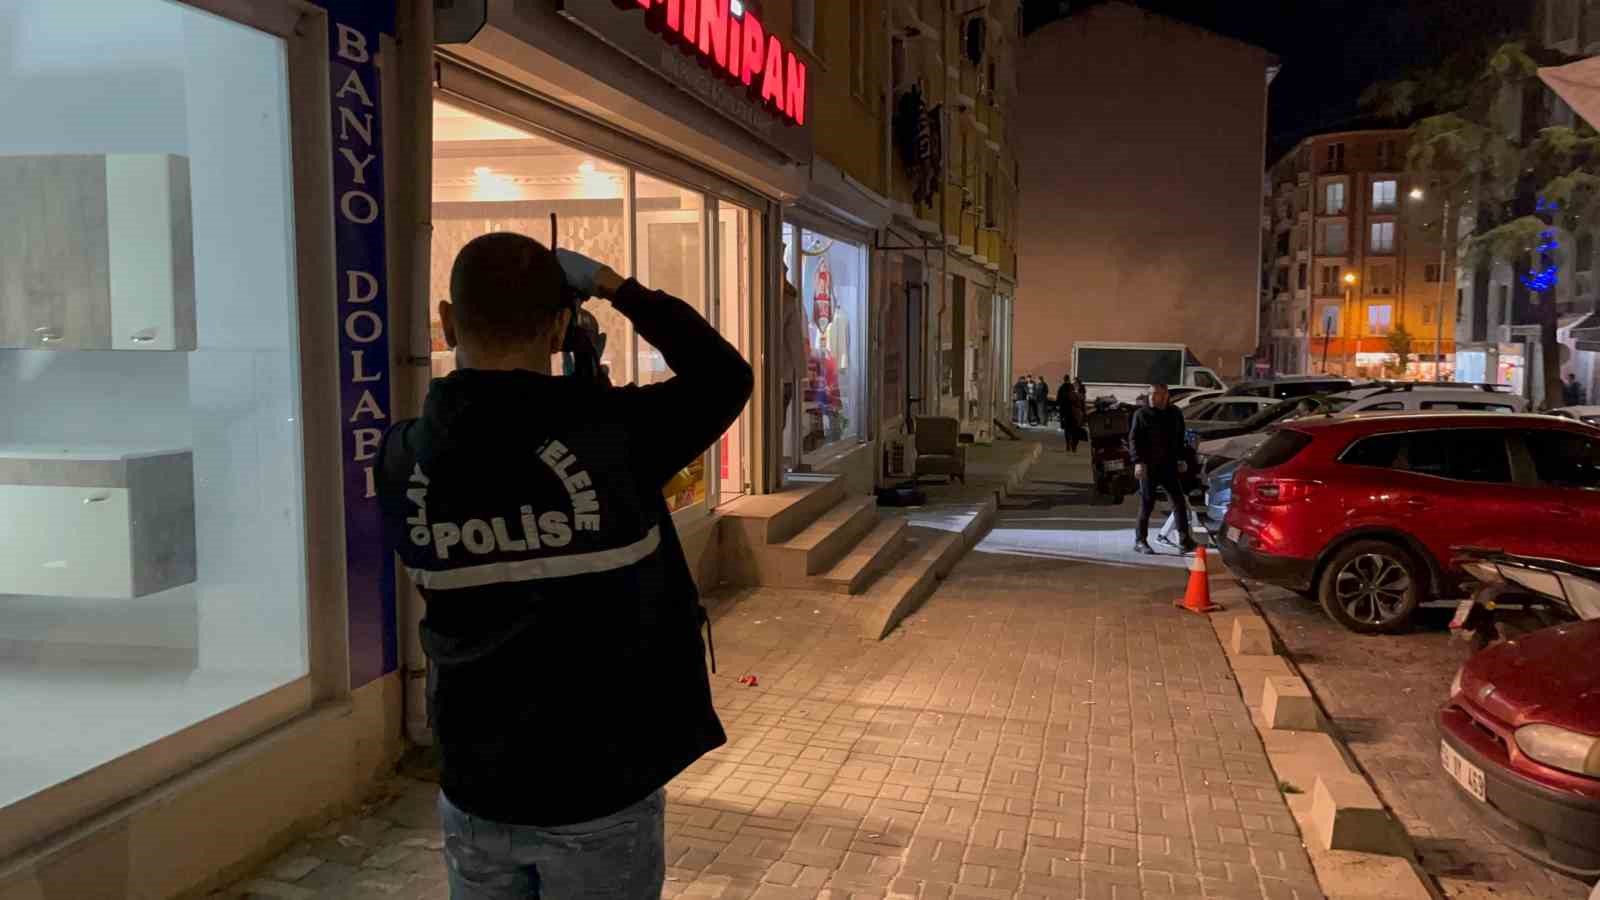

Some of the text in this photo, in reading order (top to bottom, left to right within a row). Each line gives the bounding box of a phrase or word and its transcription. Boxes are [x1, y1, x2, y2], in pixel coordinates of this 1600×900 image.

[336, 22, 386, 498] BANYO DOLABI
[432, 504, 573, 560] POLİS
[535, 438, 601, 532] ELEME
